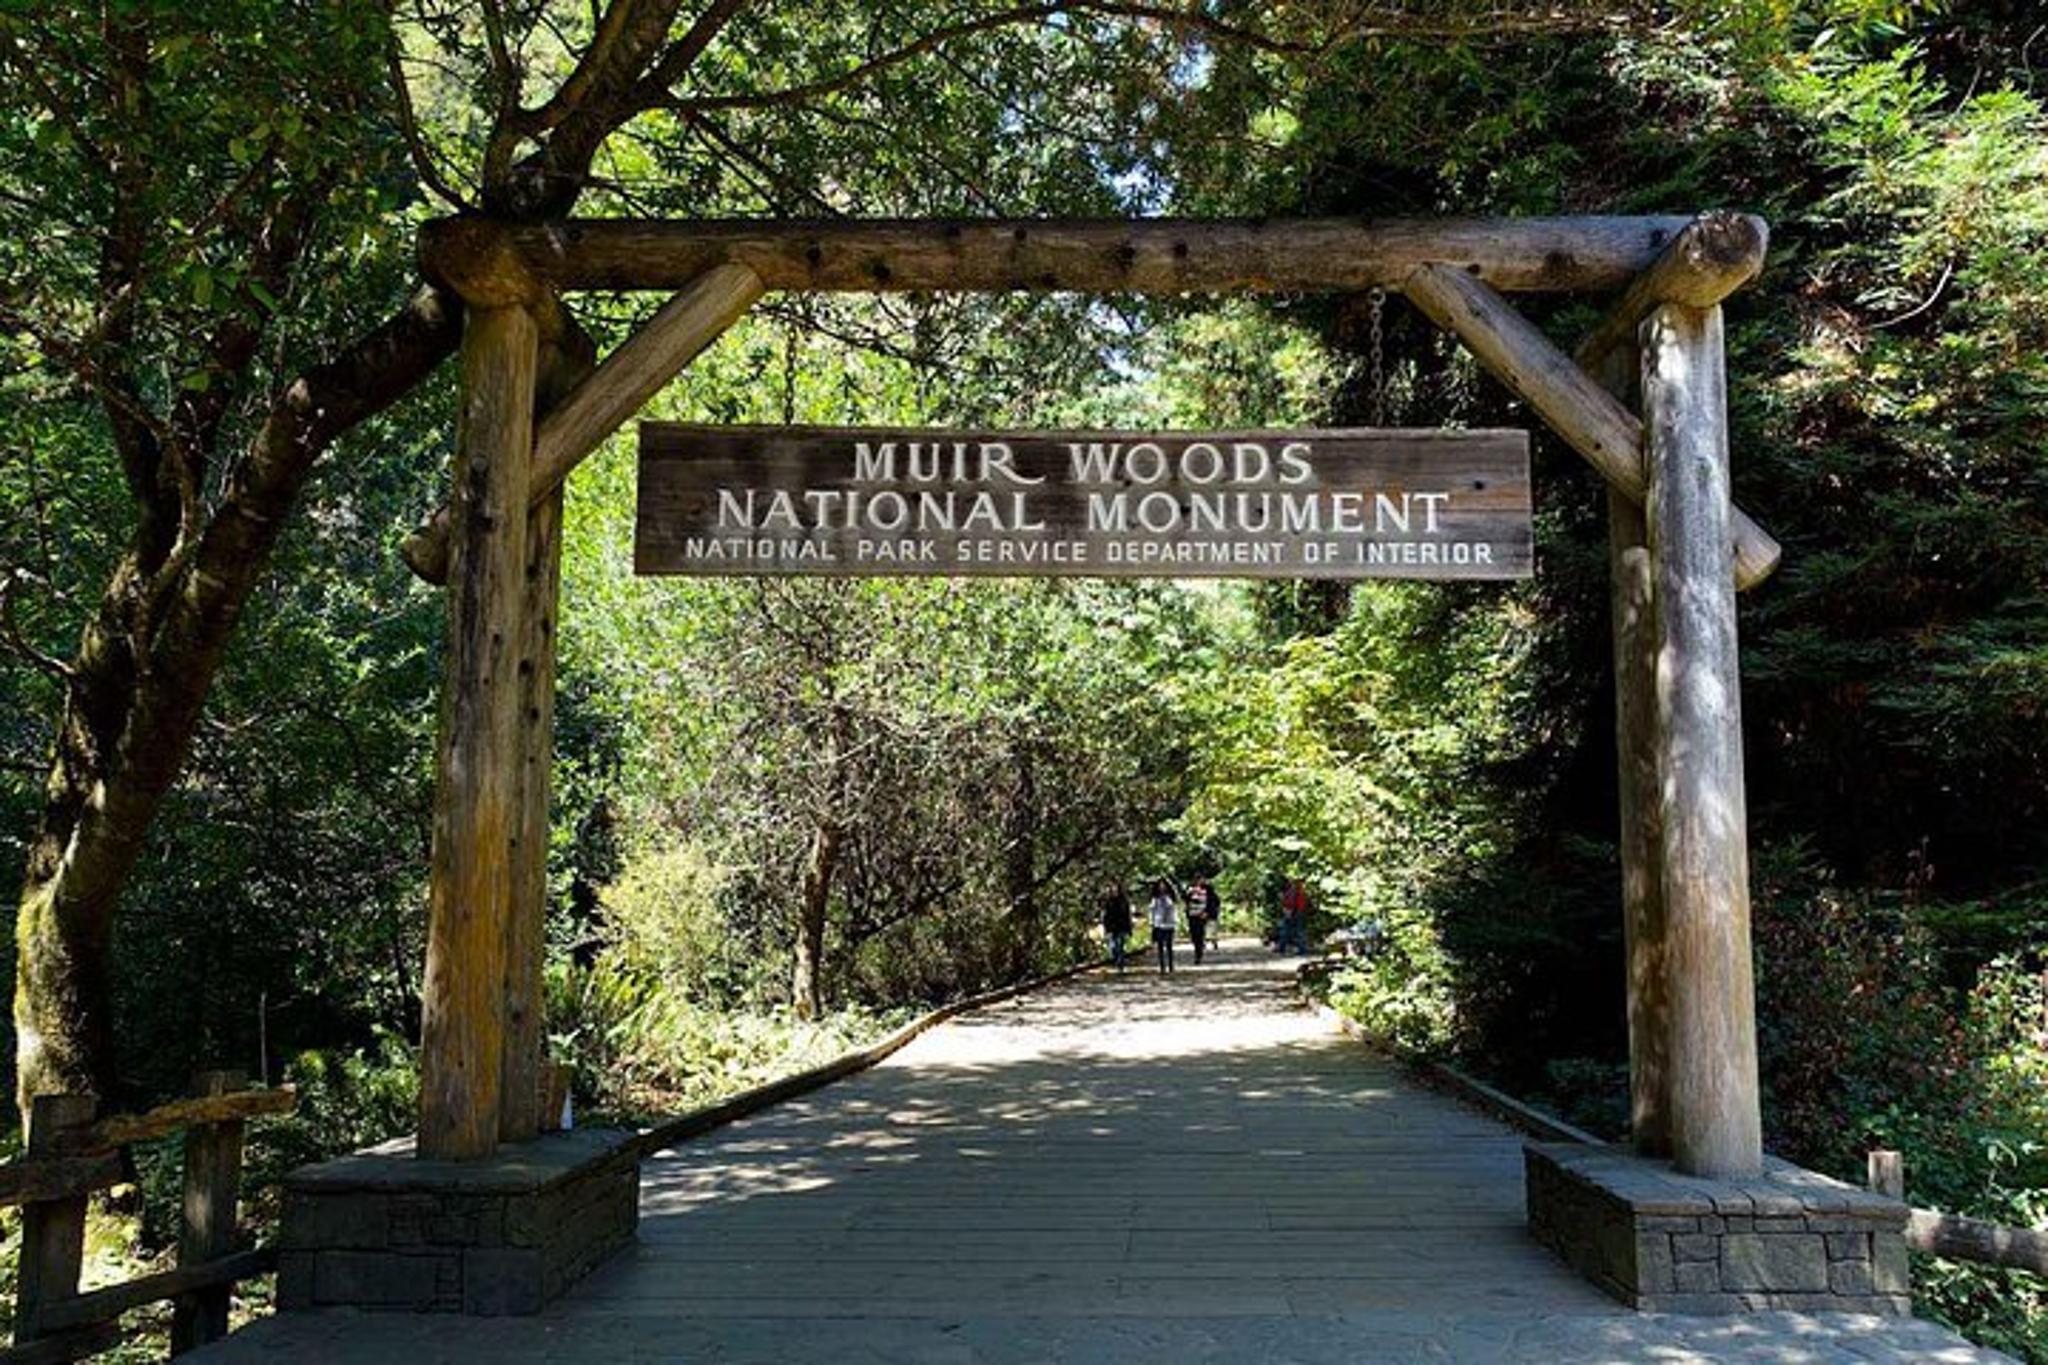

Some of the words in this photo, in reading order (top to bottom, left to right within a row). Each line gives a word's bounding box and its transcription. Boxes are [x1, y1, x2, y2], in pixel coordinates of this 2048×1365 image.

[853, 442, 1045, 485] MUIR
[1069, 442, 1314, 484] WOODS
[716, 488, 1045, 532] NATIONAL
[1087, 491, 1449, 533] MONUMENT
[685, 538, 836, 562] NATIONAL
[858, 539, 937, 562] PARK
[957, 539, 1087, 563] SERVICE
[1108, 541, 1285, 564] DEPARTMENT
[1304, 542, 1339, 564] OF
[1357, 541, 1494, 565] INTERIOR
